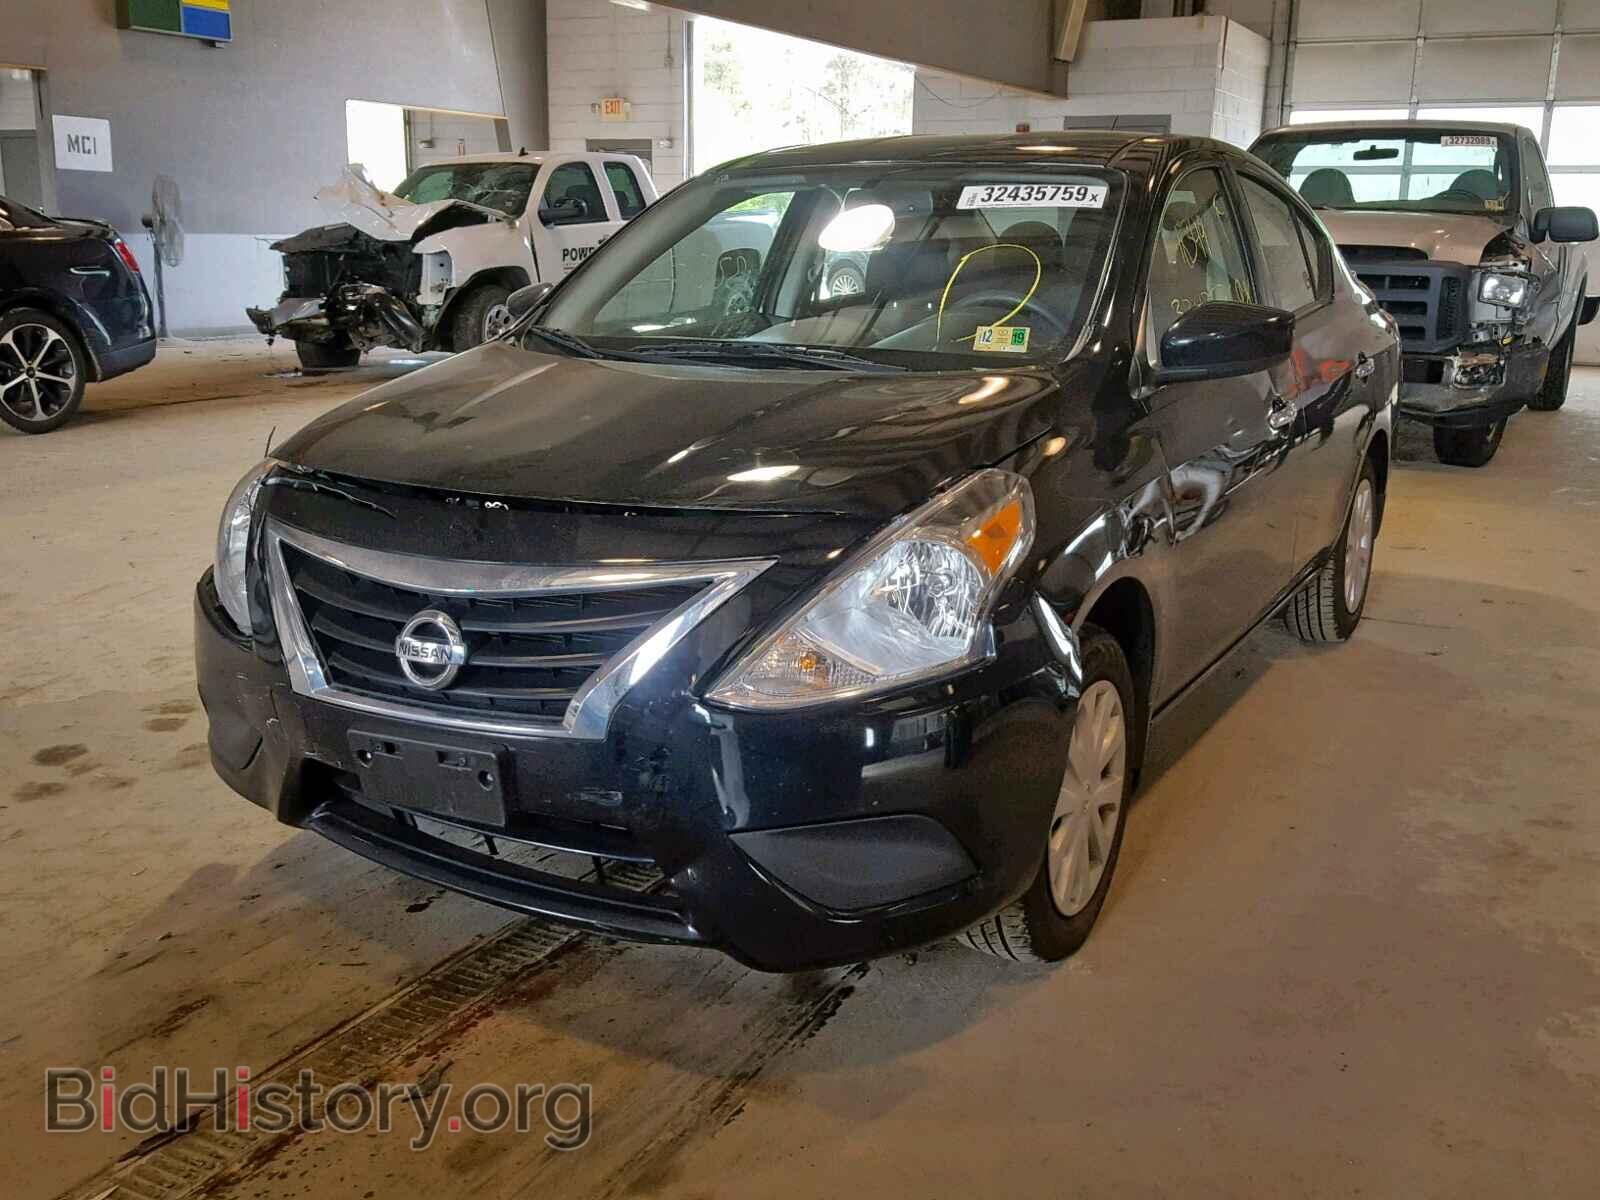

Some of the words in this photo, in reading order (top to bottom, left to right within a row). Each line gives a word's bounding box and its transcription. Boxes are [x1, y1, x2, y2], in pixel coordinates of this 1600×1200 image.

[67, 133, 97, 155] MCI
[981, 328, 993, 343] 12
[1012, 331, 1025, 345] 19
[398, 640, 450, 662] NISSAN
